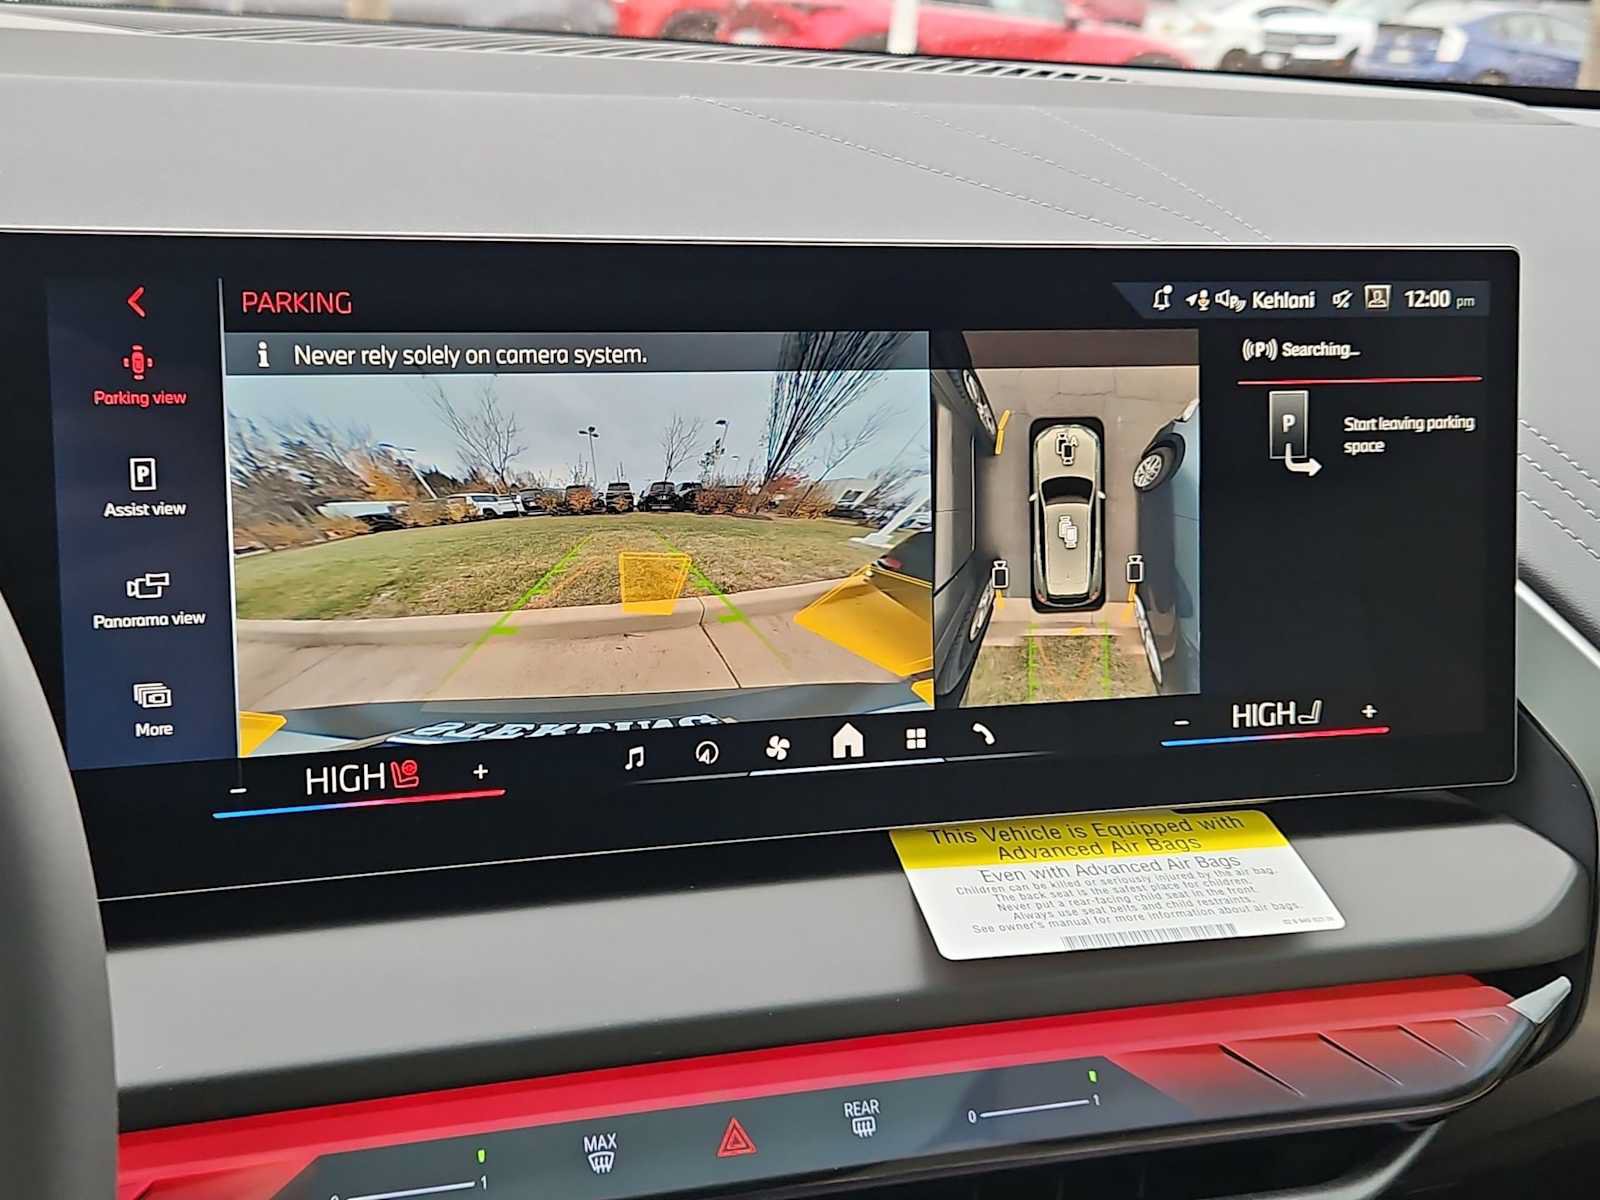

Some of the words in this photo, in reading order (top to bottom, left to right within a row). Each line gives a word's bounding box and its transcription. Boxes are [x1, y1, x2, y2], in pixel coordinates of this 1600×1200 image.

[242, 291, 352, 314] PARKING
[1252, 290, 1316, 309] Kehlani
[1404, 290, 1450, 308] 12:00
[1456, 296, 1475, 309] pm
[294, 344, 356, 366] Never
[361, 344, 398, 369] rely
[403, 344, 460, 368] solely
[468, 348, 490, 364] on
[496, 348, 568, 365] camera
[574, 346, 648, 368] system.
[94, 390, 150, 408] Parking
[152, 390, 187, 404] view
[1344, 416, 1376, 431] Start
[1378, 416, 1425, 432] leaving
[1426, 415, 1475, 432] parking
[1344, 440, 1384, 455] space
[104, 502, 150, 517] Assist
[151, 502, 186, 515] view
[93, 614, 168, 629] Panorama
[171, 611, 206, 624] view
[1232, 701, 1296, 728] HIGH
[135, 723, 174, 736] More
[306, 762, 385, 796] HIGH
[927, 829, 977, 844] This
[980, 825, 1062, 842] Vehicle
[1066, 824, 1088, 838] is
[1091, 818, 1192, 838] Equipped
[1197, 814, 1244, 830] with
[999, 842, 1104, 860] Advanced
[1111, 839, 1140, 854] Air
[1146, 836, 1202, 852] Bags
[978, 868, 1026, 884] Even
[1030, 866, 1070, 880] with
[1075, 861, 1162, 878] Advanced
[1168, 858, 1192, 870] Air
[1194, 855, 1240, 870] Bags
[956, 886, 1005, 896] Children
[1010, 884, 1029, 892] can
[1032, 881, 1047, 890] be
[1051, 879, 1081, 890] killed
[1084, 878, 1097, 886] or
[1101, 874, 1152, 886] seriously
[1154, 872, 1194, 884] injured
[1199, 870, 1212, 880] by
[1214, 868, 1232, 877] the
[1236, 868, 1250, 876] air
[994, 893, 1016, 903] The
[1020, 891, 1046, 902] back
[1050, 889, 1075, 900] seat
[1077, 886, 1088, 896] is
[1090, 885, 1111, 896] the
[1113, 883, 1148, 894] safest
[1152, 882, 1179, 892] place
[1182, 880, 1200, 890] for
[1202, 878, 1253, 888] children.
[997, 902, 1031, 913] Never
[1036, 901, 1056, 911] put
[1069, 895, 1132, 908] rear-facing
[1134, 891, 1162, 902] child
[1165, 889, 1190, 899] seat
[1192, 888, 1206, 898] in
[1207, 888, 1225, 897] the
[1014, 910, 1054, 921] Always
[1058, 908, 1078, 917] use
[1082, 906, 1107, 916] seat
[1111, 904, 1136, 914] belts
[1142, 902, 1162, 910] and
[1166, 899, 1194, 910] child
[1197, 896, 1255, 907] restraints.
[972, 924, 997, 934] See
[999, 920, 1046, 932] owner's
[1048, 916, 1092, 928] manual
[1094, 914, 1112, 924] for
[1115, 912, 1145, 922] more
[1150, 908, 1215, 921] information
[1218, 904, 1250, 914] about
[1254, 904, 1268, 912] air
[844, 1098, 880, 1118] REAR
[1093, 1093, 1100, 1106] 1
[968, 1110, 976, 1124] 0
[584, 1132, 618, 1152] MAX
[480, 1175, 488, 1190] 1
